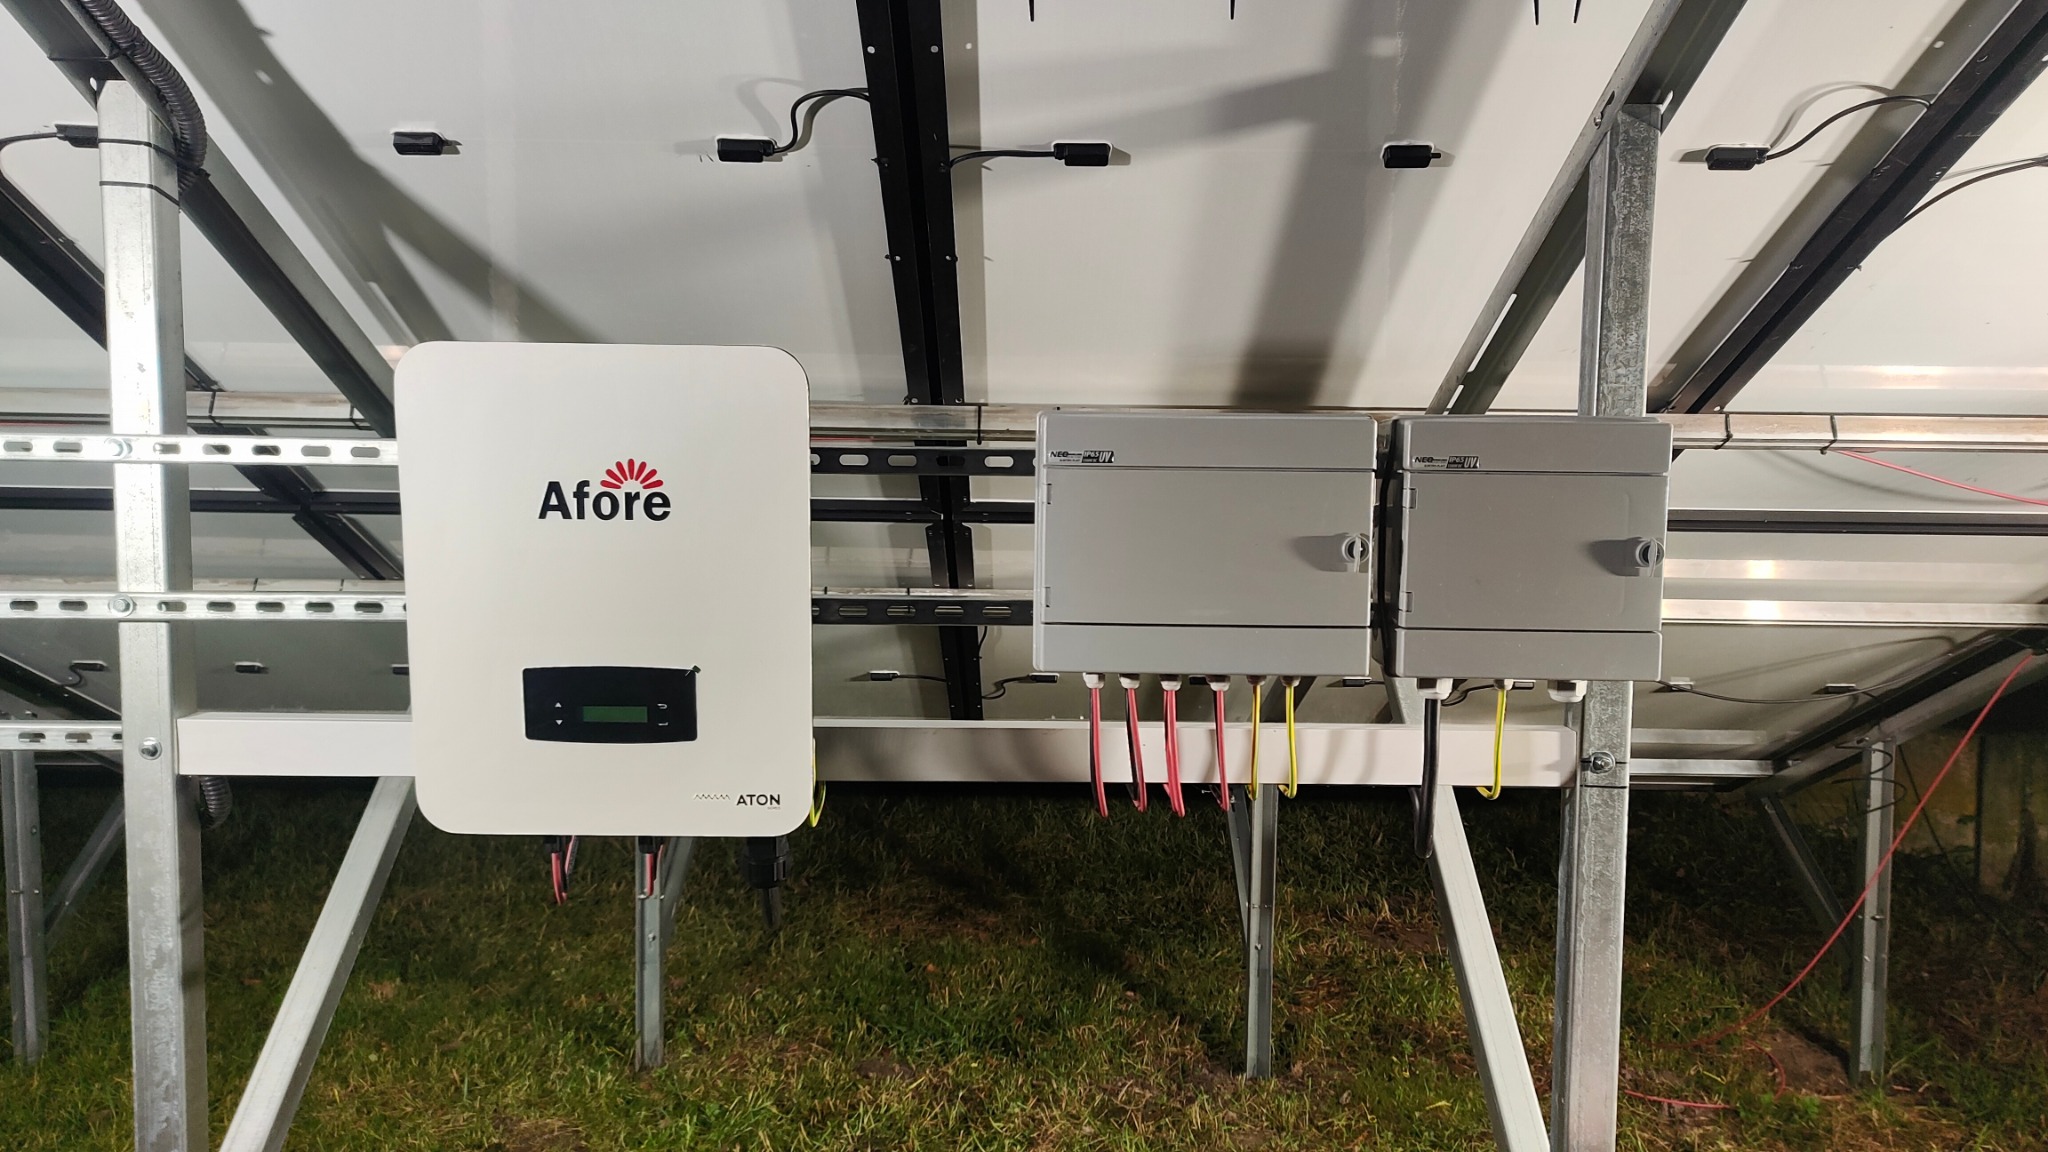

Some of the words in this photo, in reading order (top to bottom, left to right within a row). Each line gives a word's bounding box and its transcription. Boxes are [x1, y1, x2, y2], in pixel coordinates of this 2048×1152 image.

[1099, 451, 1112, 463] UV
[1463, 456, 1477, 468] UV
[538, 480, 671, 521] Afore
[736, 794, 781, 806] ATON
